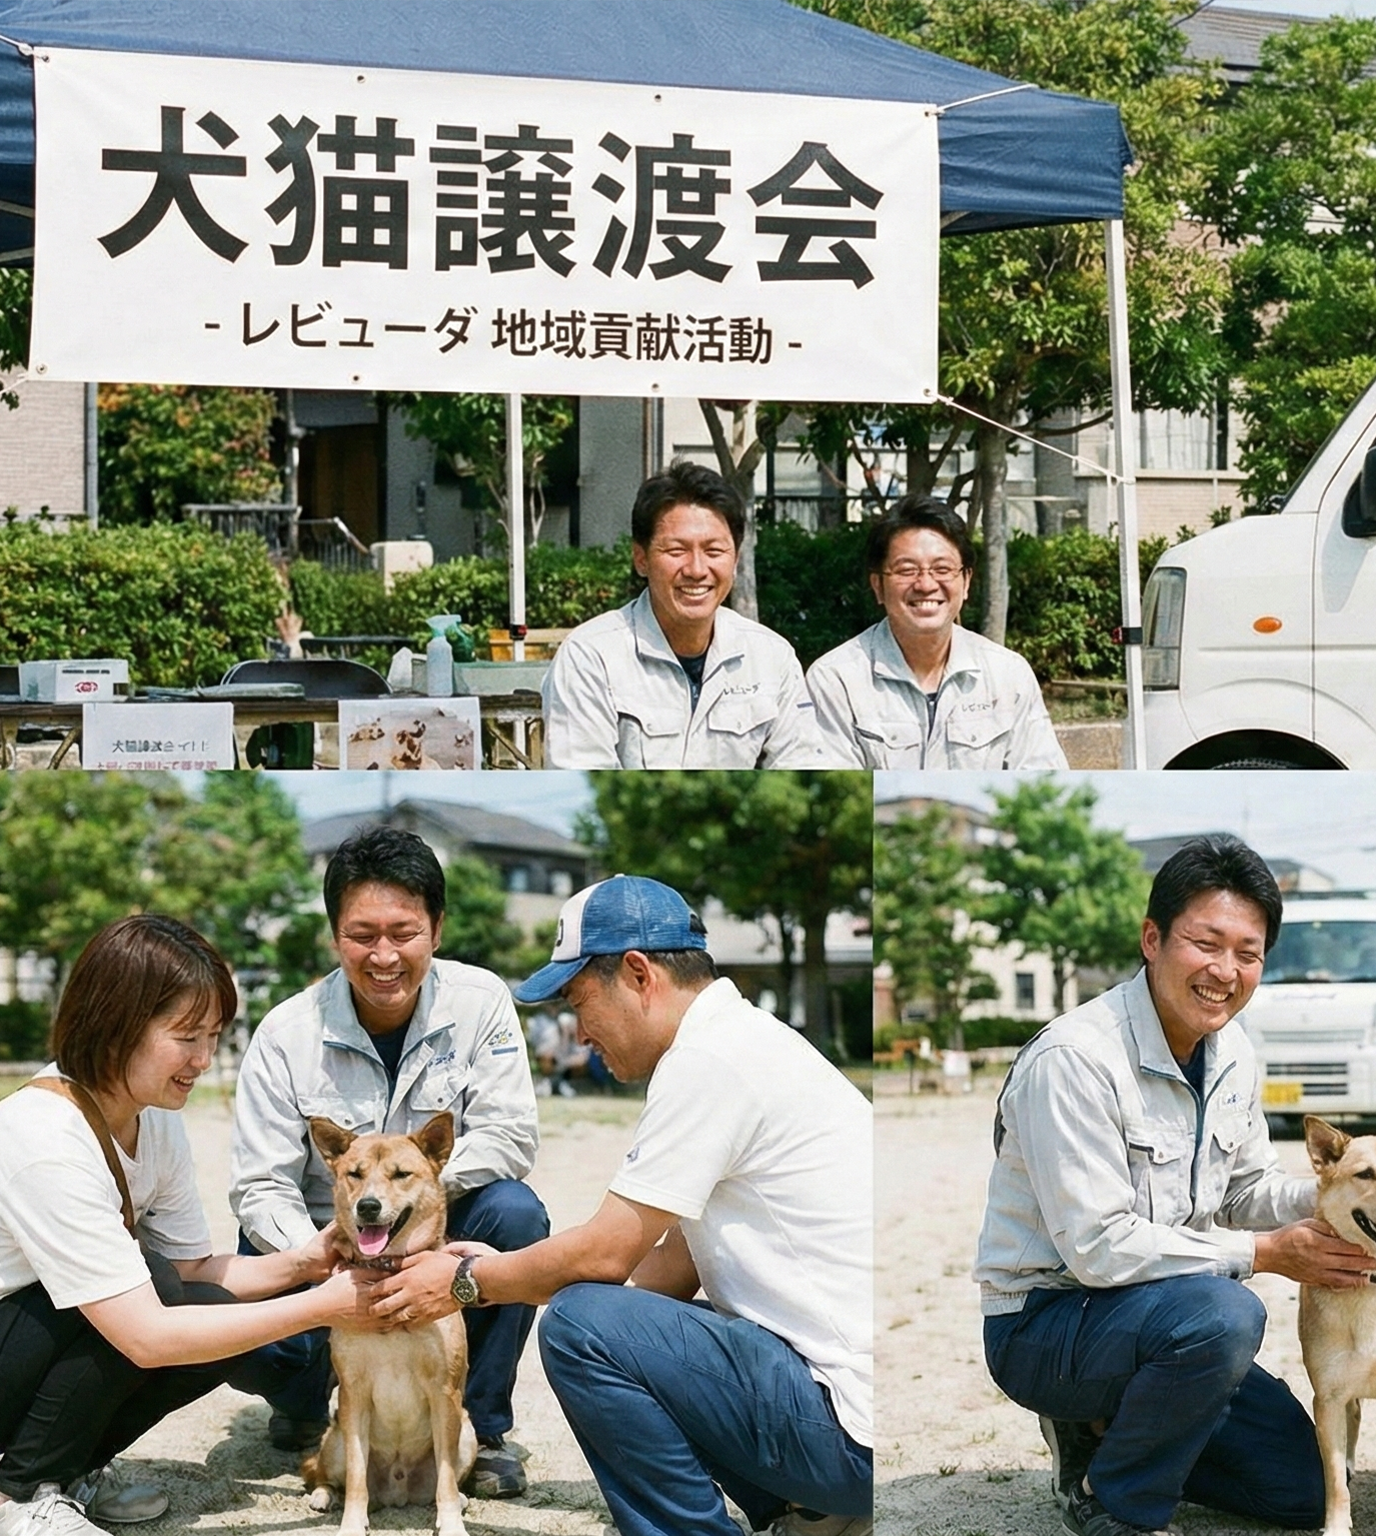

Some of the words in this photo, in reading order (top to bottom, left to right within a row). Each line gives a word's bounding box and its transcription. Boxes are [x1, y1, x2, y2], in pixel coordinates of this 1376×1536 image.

[98, 105, 884, 290] 犬猫譲渡会
[242, 301, 479, 354] レビューダ
[491, 308, 773, 366] 地域貢献活動
